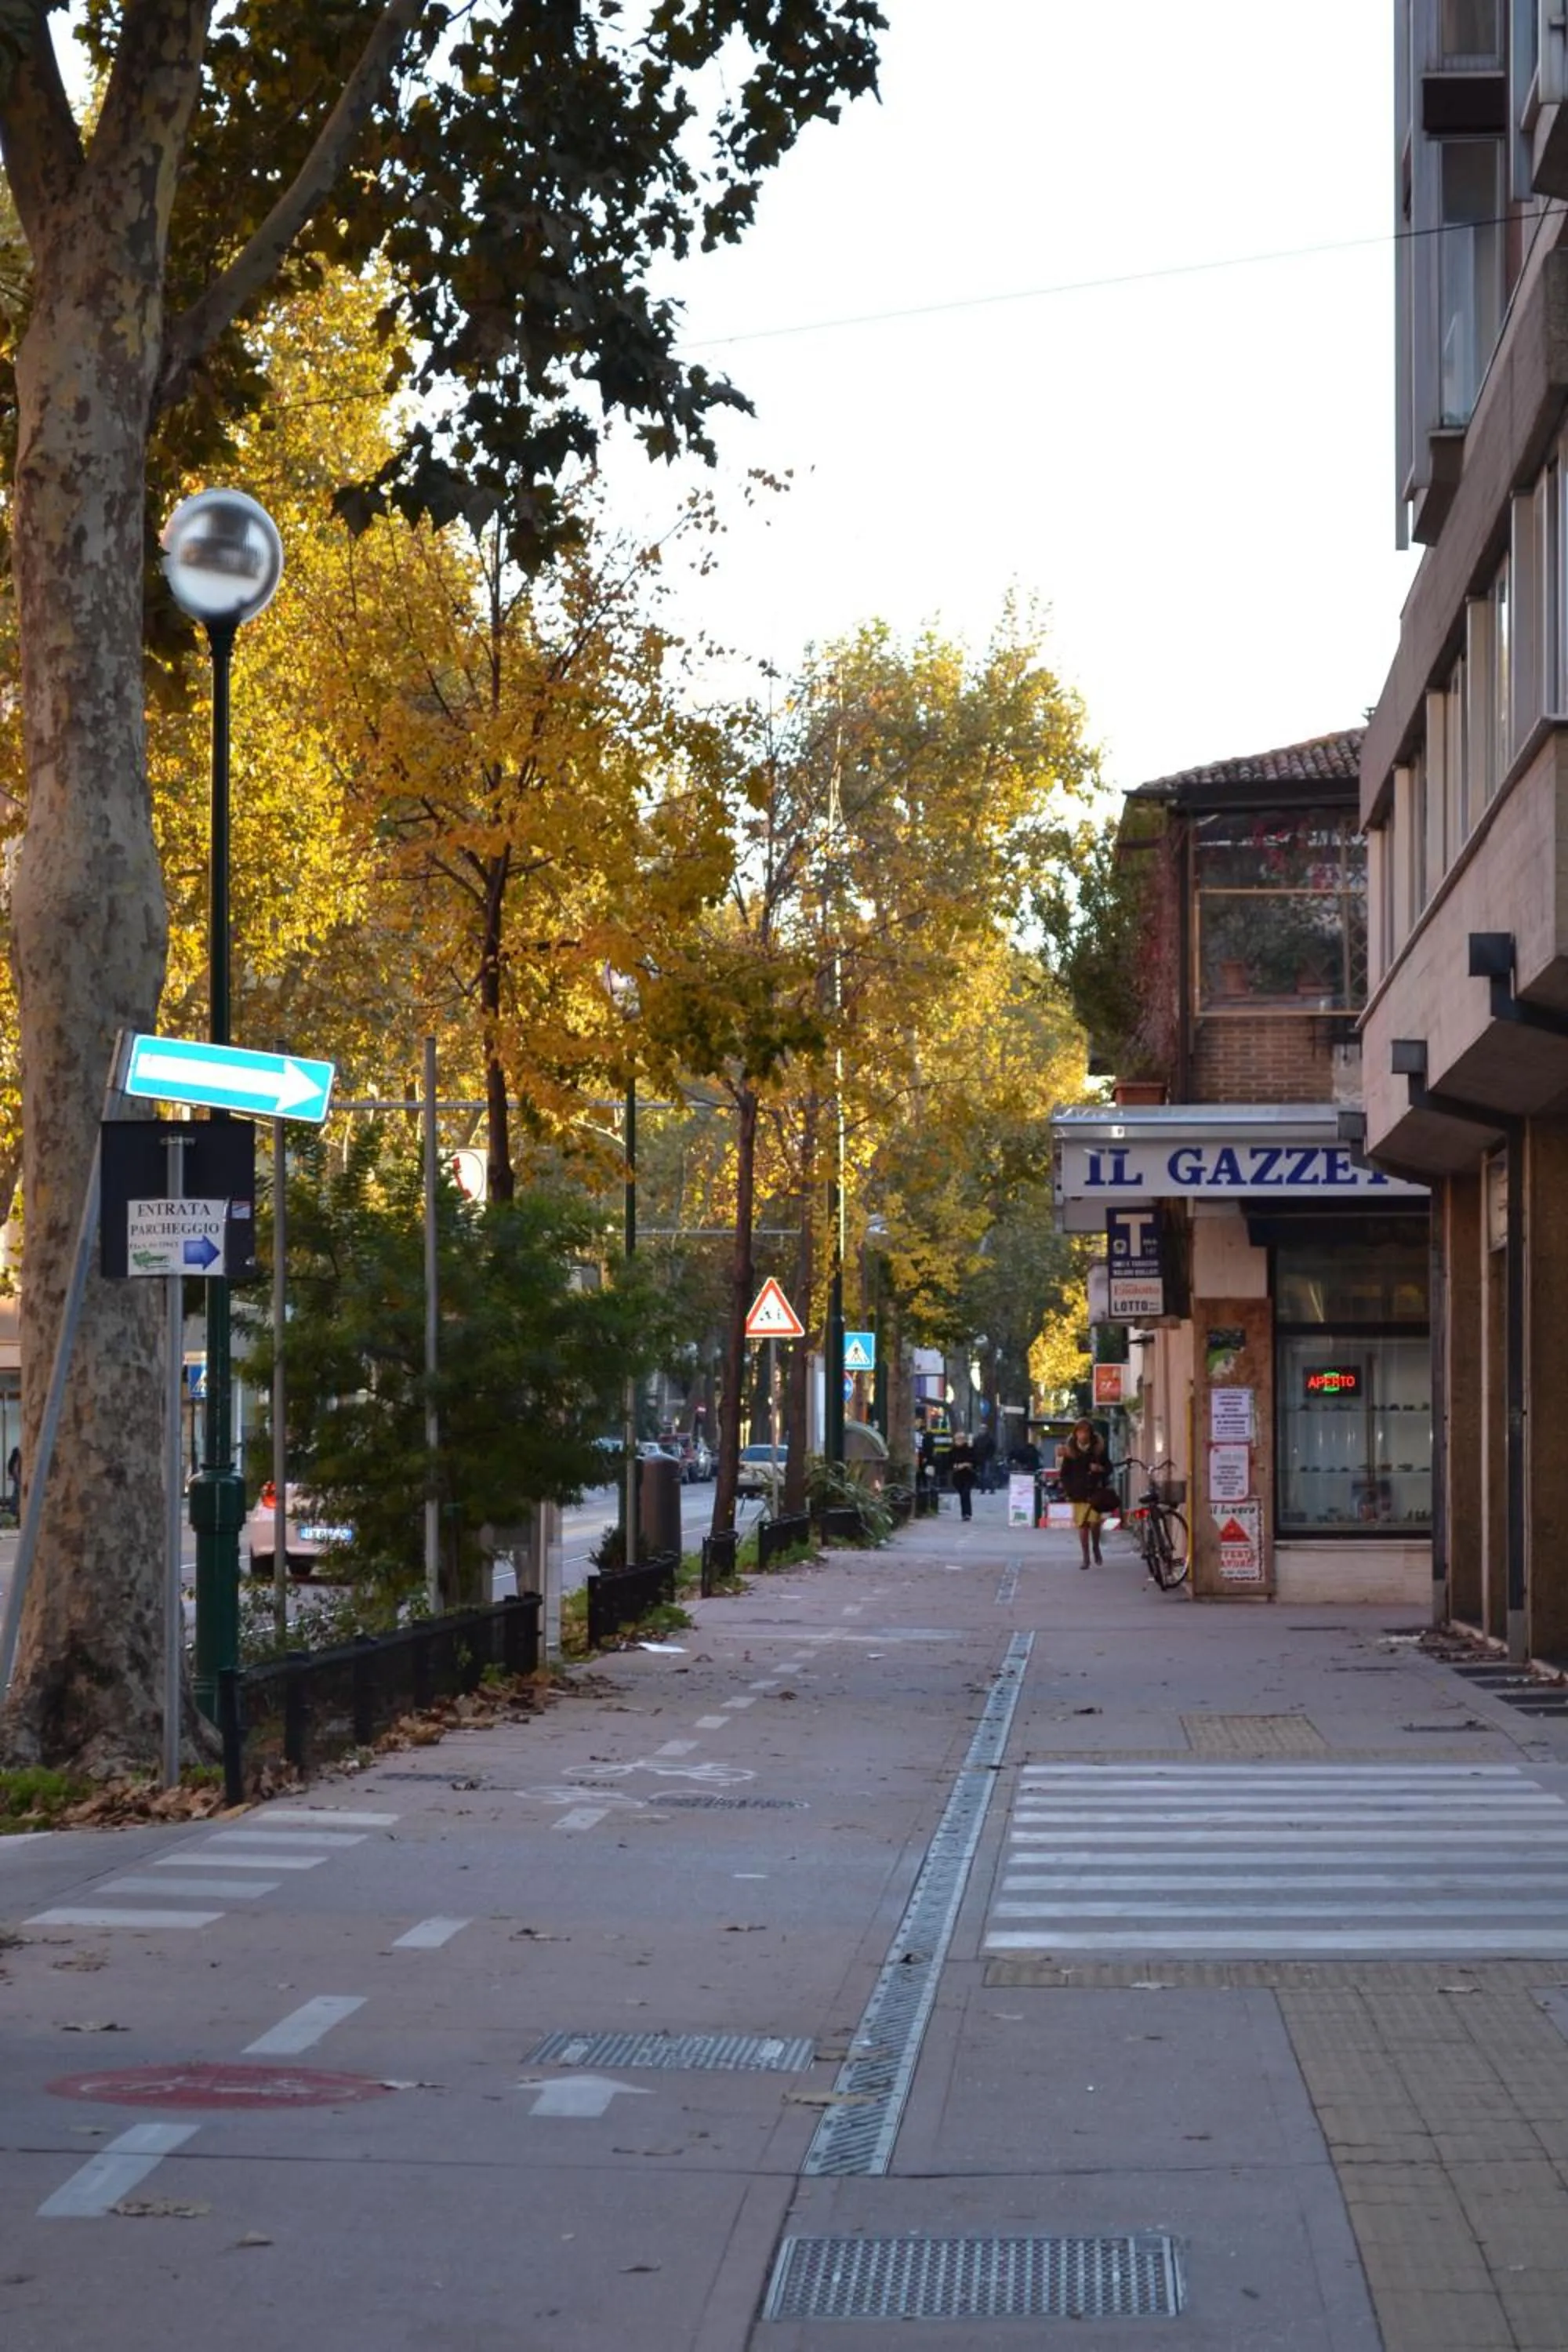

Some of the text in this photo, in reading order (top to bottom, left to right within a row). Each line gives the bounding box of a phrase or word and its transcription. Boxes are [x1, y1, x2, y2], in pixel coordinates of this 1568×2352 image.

[1084, 1148, 1142, 1185] IL
[137, 1203, 212, 1217] ENTRATA
[130, 1222, 220, 1236] PARCHEGGIO
[1115, 1214, 1153, 1257] T
[1113, 1300, 1149, 1312] LOTTO
[1307, 1375, 1356, 1388] APERTO
